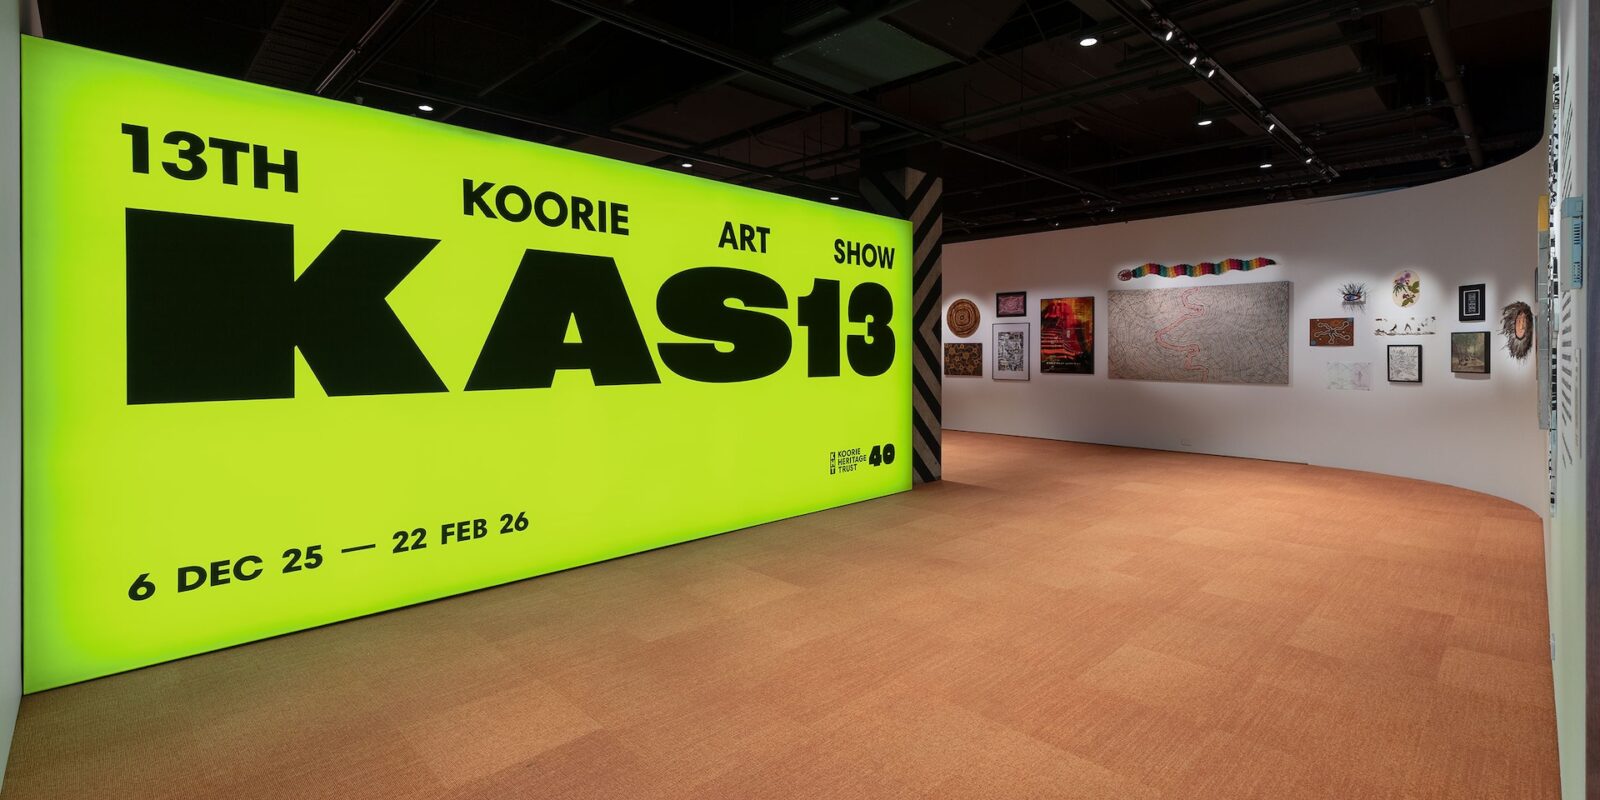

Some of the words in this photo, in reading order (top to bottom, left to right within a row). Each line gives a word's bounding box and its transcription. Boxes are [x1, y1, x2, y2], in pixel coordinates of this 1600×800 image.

[121, 122, 299, 194] 13TH
[462, 178, 629, 236] KOORIE
[718, 221, 771, 254] ART
[833, 238, 895, 270] SHOW
[125, 207, 896, 406] KAS13
[837, 447, 861, 458] KOORIE
[837, 454, 867, 466] HERITAGE
[868, 443, 896, 467] 40
[838, 463, 858, 473] TRUST
[128, 573, 156, 601] 6
[177, 555, 263, 593] DEC
[282, 544, 323, 574] 25
[392, 527, 427, 554] 22
[441, 518, 488, 545] FEB
[500, 511, 529, 535] 26
